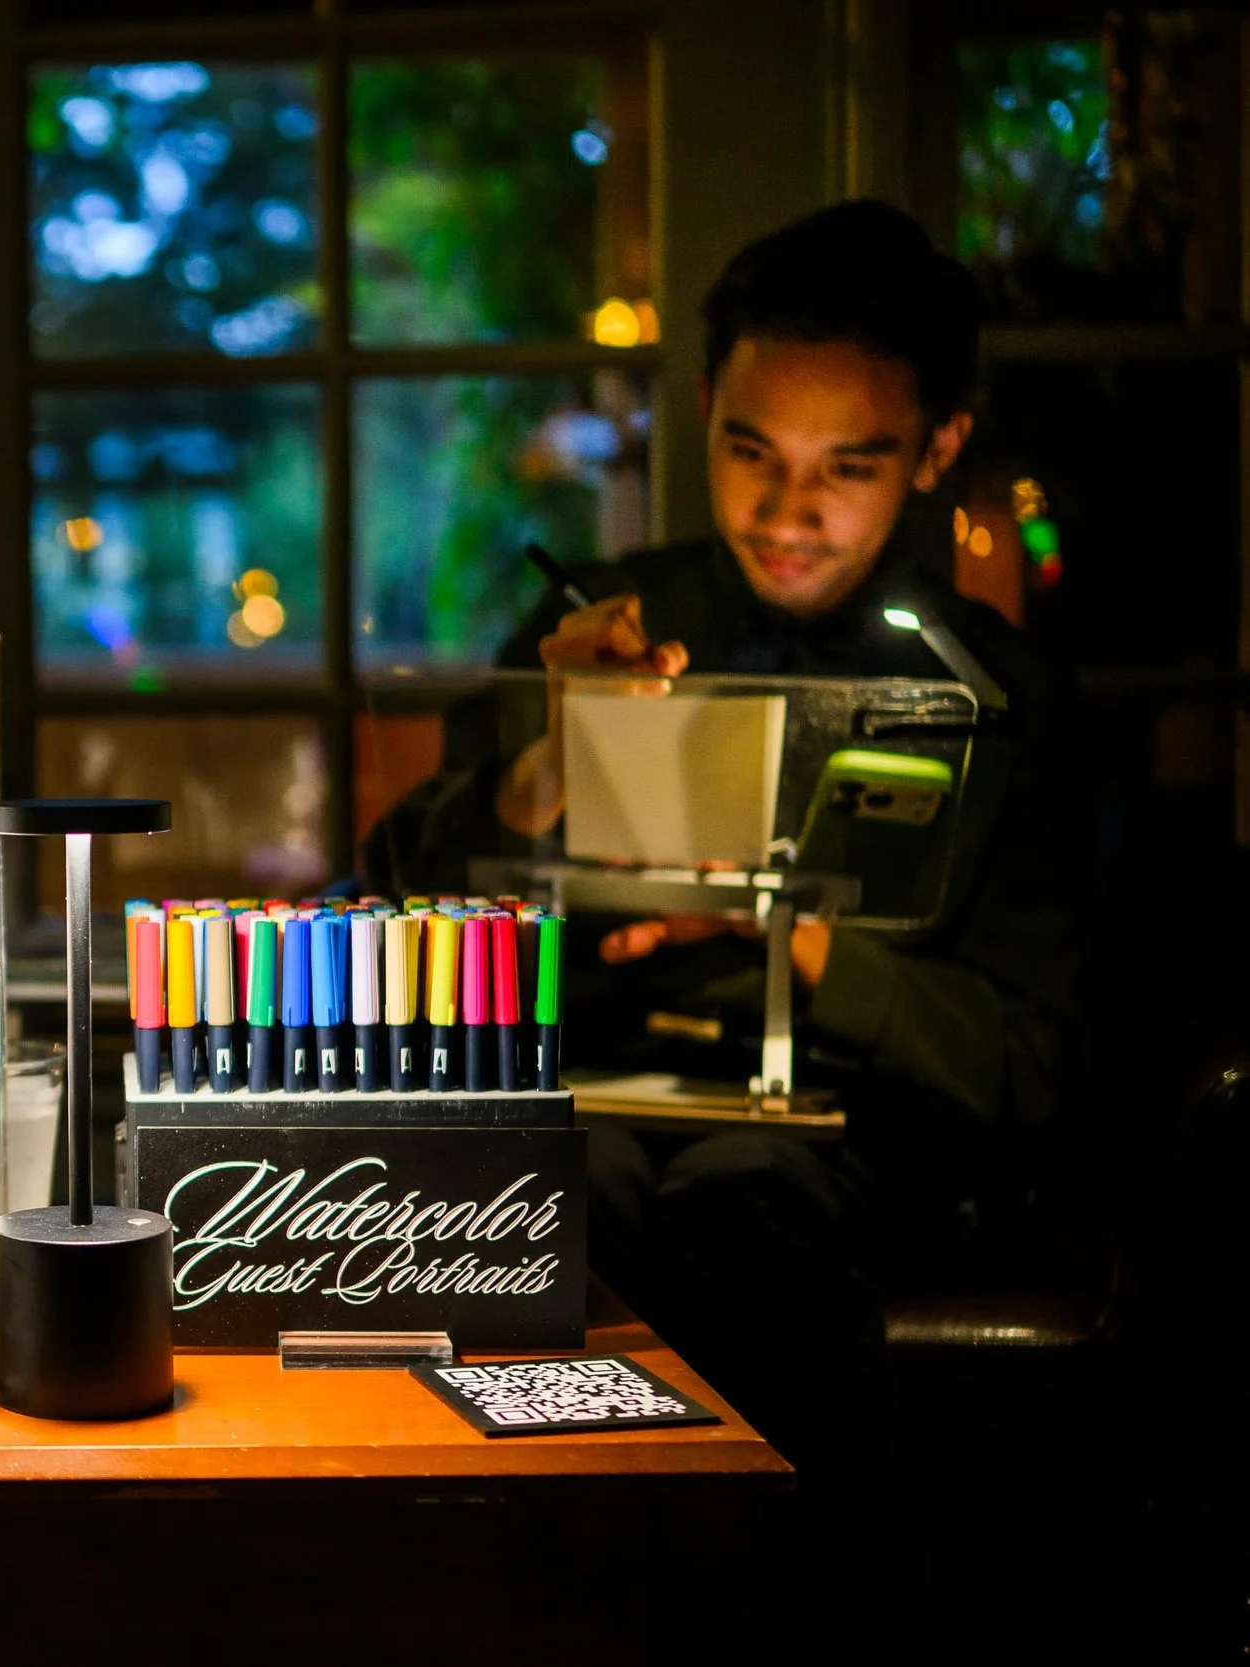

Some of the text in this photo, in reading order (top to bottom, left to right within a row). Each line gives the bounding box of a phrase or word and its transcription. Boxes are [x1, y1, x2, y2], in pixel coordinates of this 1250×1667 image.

[164, 1157, 564, 1243] Watercolor
[172, 1234, 559, 1310] Guest Portraits
